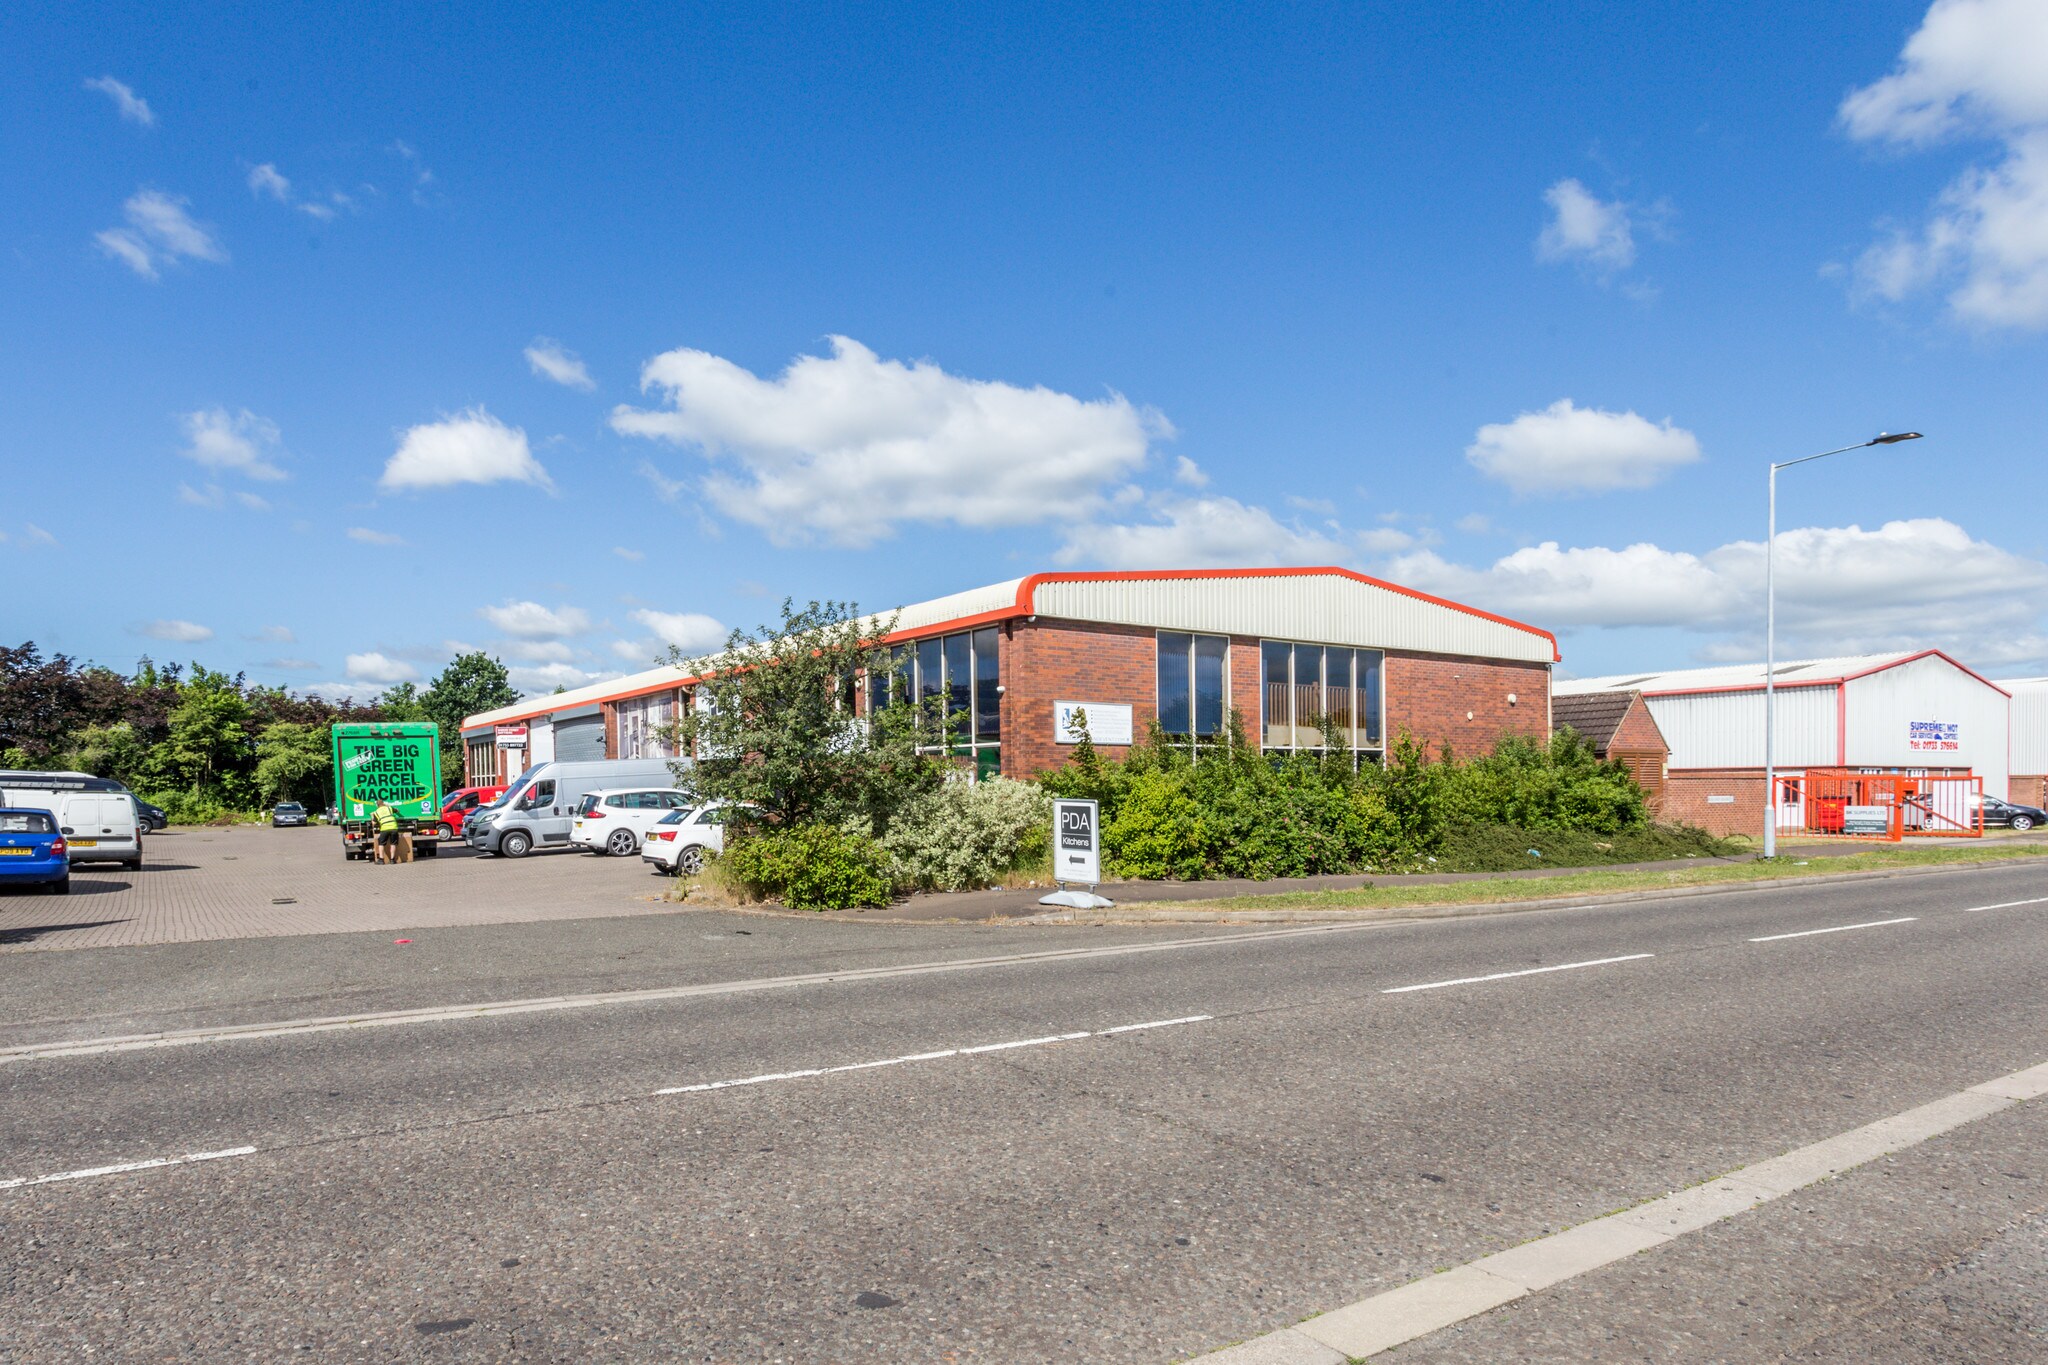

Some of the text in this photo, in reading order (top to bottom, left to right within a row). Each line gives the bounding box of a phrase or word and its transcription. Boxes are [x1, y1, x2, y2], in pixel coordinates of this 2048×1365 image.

[1910, 722, 1942, 731] SUPREME
[354, 744, 419, 758] THE BIG
[360, 759, 415, 773] GREEN
[357, 773, 419, 787] PARCEL
[354, 787, 425, 801] MACHINE
[1061, 812, 1090, 830] PDA
[1062, 836, 1090, 847] Kitchens
